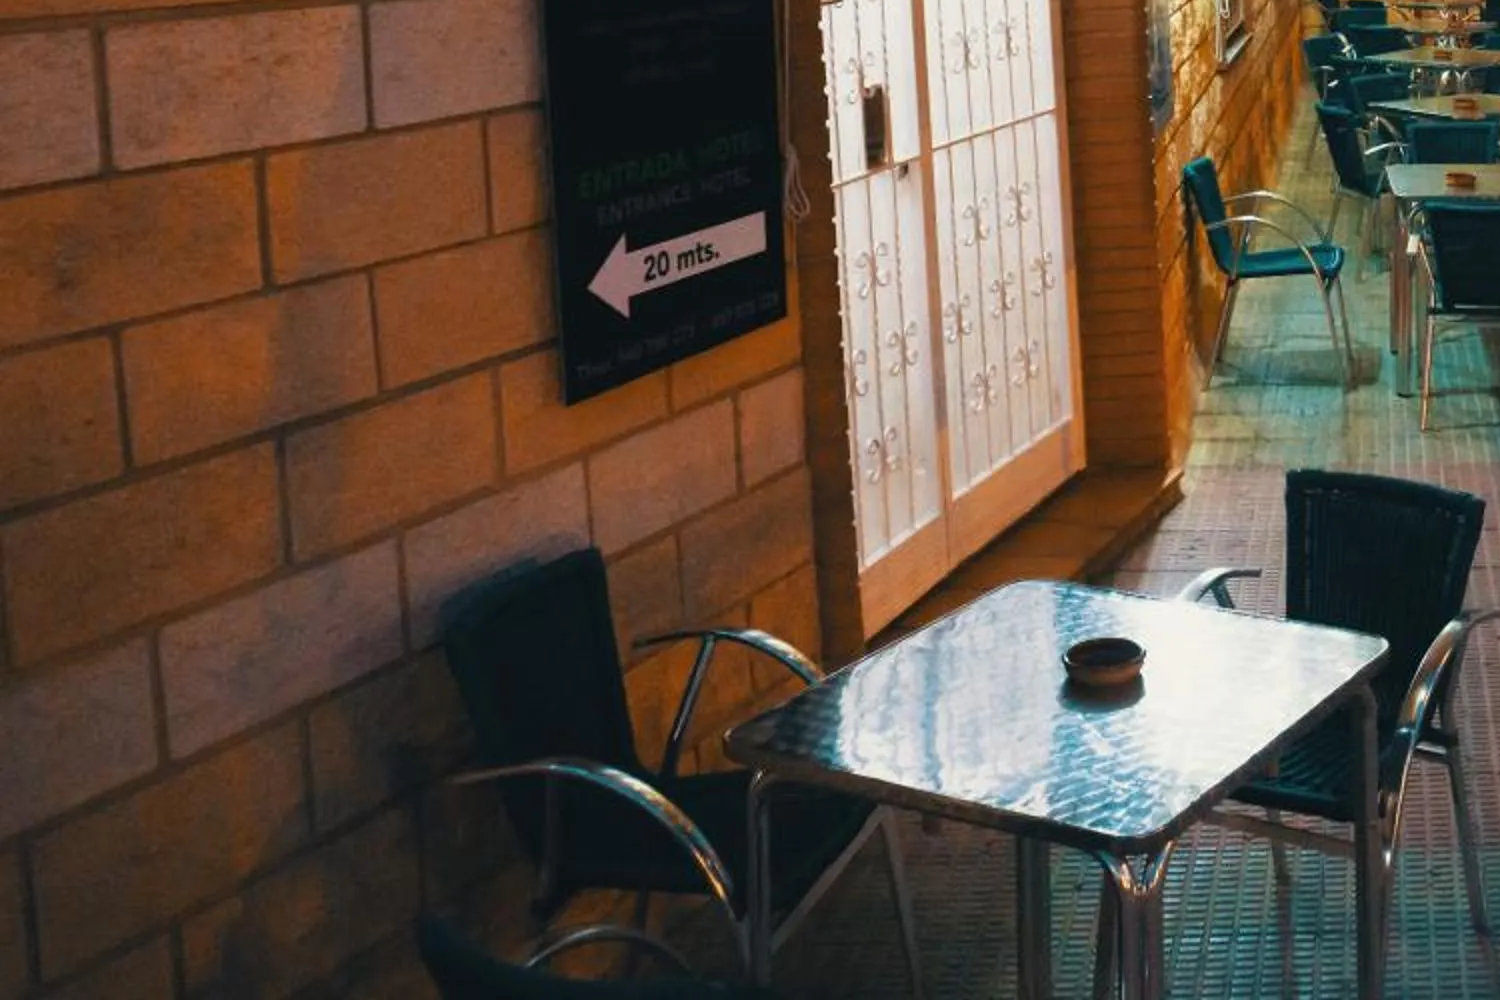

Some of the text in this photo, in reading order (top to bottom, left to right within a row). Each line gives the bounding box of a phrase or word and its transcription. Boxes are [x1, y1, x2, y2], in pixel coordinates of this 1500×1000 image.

[579, 148, 689, 198] ENTRADA
[643, 242, 720, 283] 20 mts.
